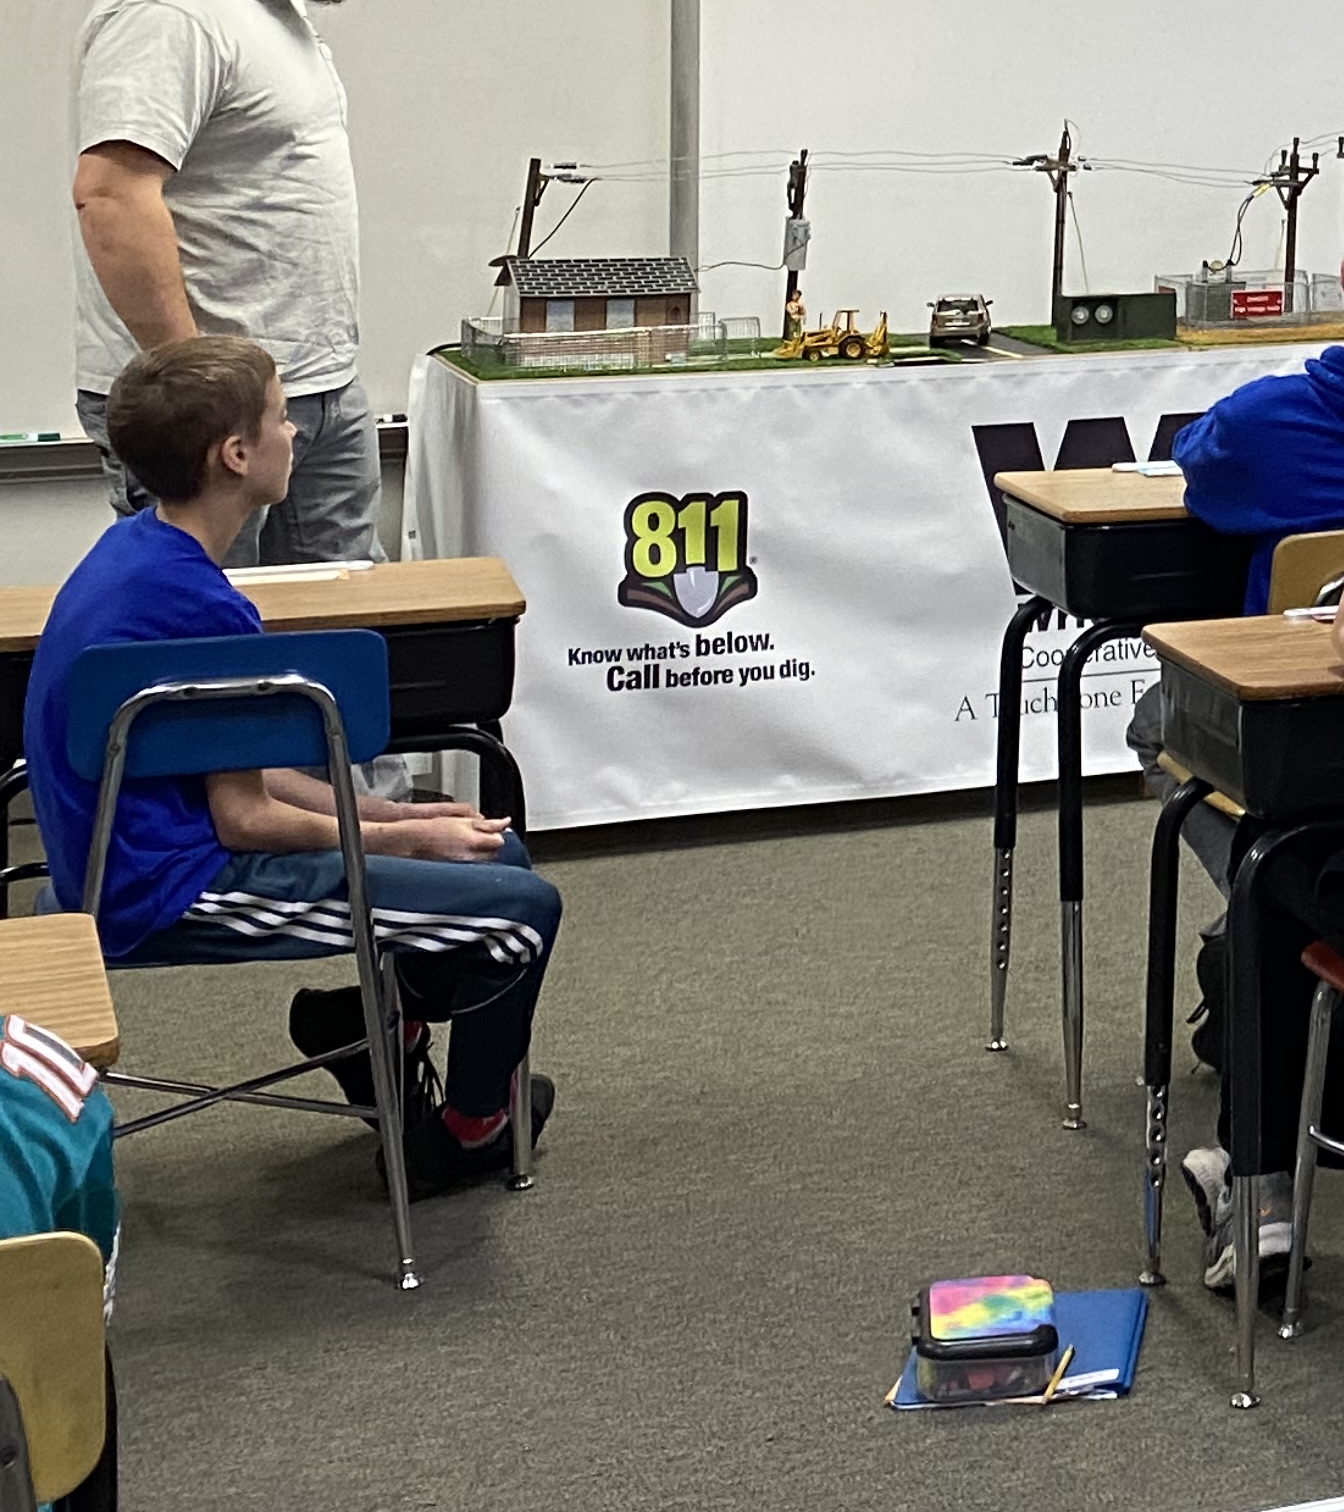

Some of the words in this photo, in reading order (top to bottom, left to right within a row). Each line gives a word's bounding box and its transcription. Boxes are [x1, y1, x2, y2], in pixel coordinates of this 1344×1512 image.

[630, 498, 740, 579] 811
[568, 647, 622, 666] Know
[626, 640, 690, 663] what's
[695, 631, 775, 657] below.
[606, 664, 660, 692] Call
[665, 666, 734, 689] before
[738, 662, 775, 687] you
[779, 658, 816, 682] dig.
[954, 695, 978, 723] A
